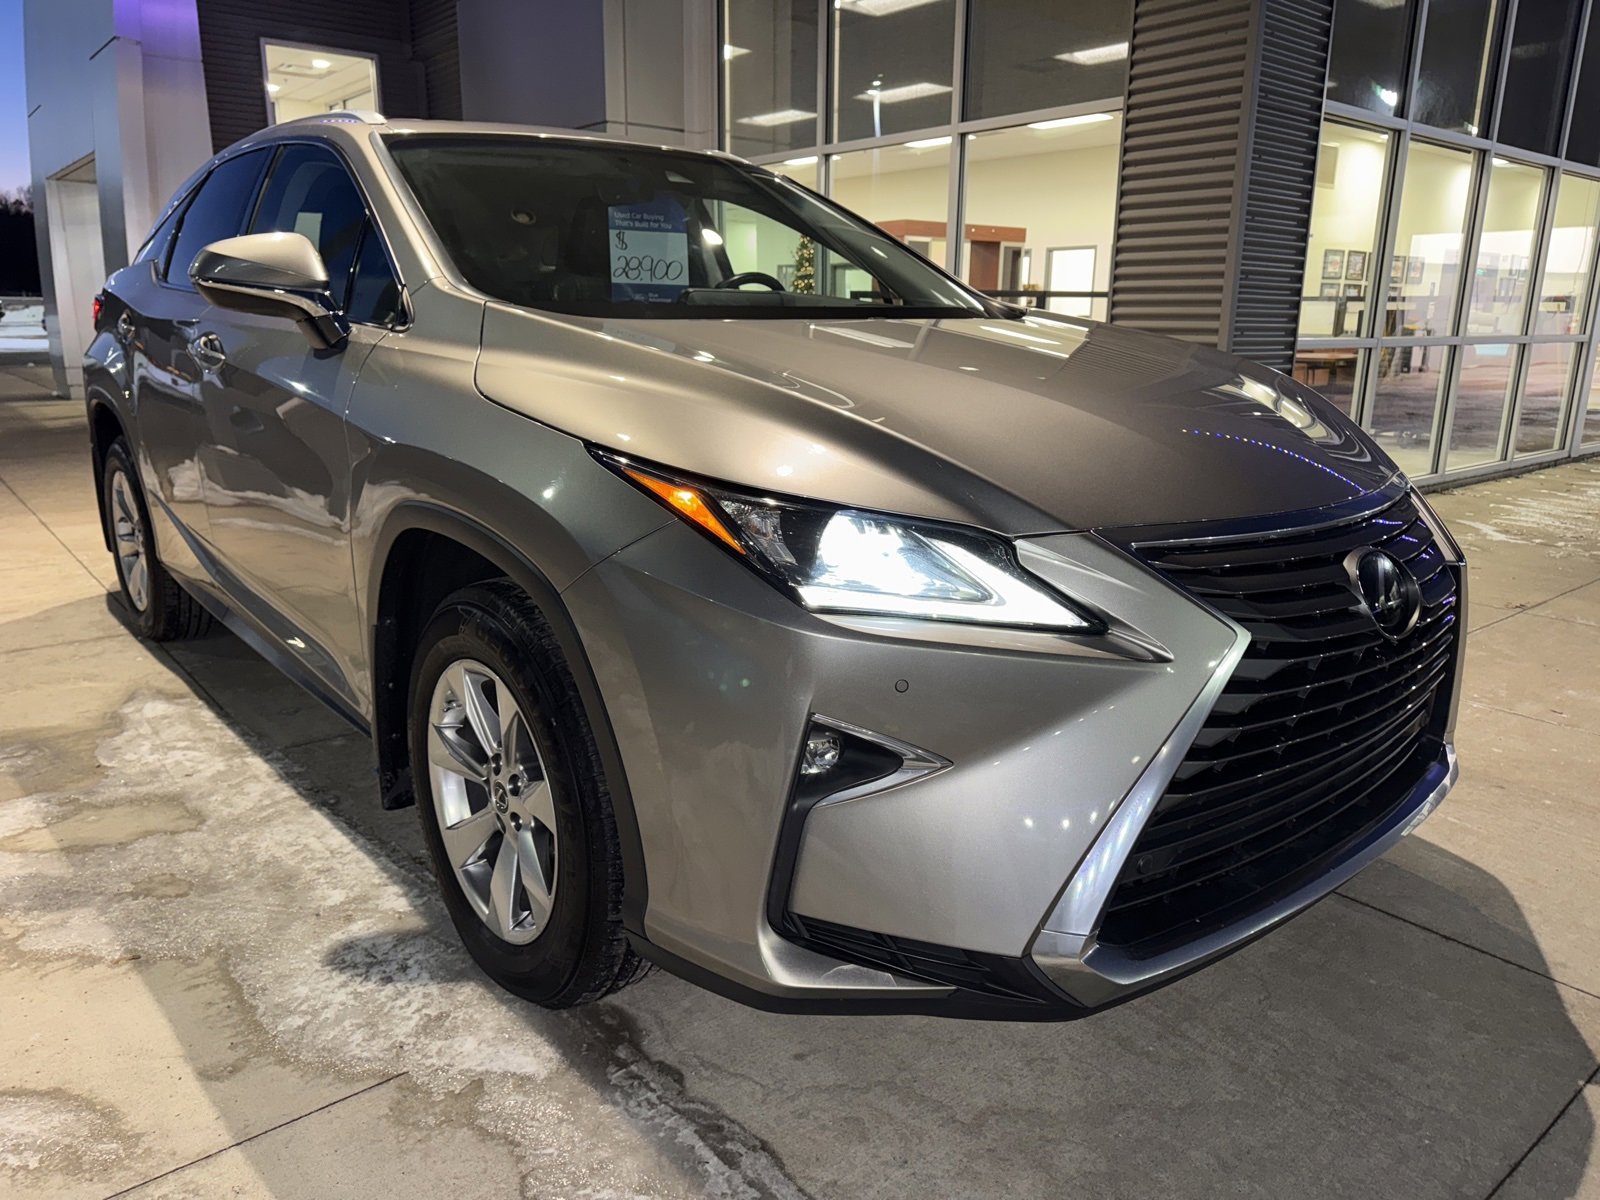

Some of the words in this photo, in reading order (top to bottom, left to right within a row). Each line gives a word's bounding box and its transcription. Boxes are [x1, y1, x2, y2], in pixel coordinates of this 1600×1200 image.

[613, 211, 630, 219] Used
[643, 212, 664, 222] Buying
[634, 220, 649, 228] Built
[660, 222, 673, 230] You
[615, 231, 628, 250] $
